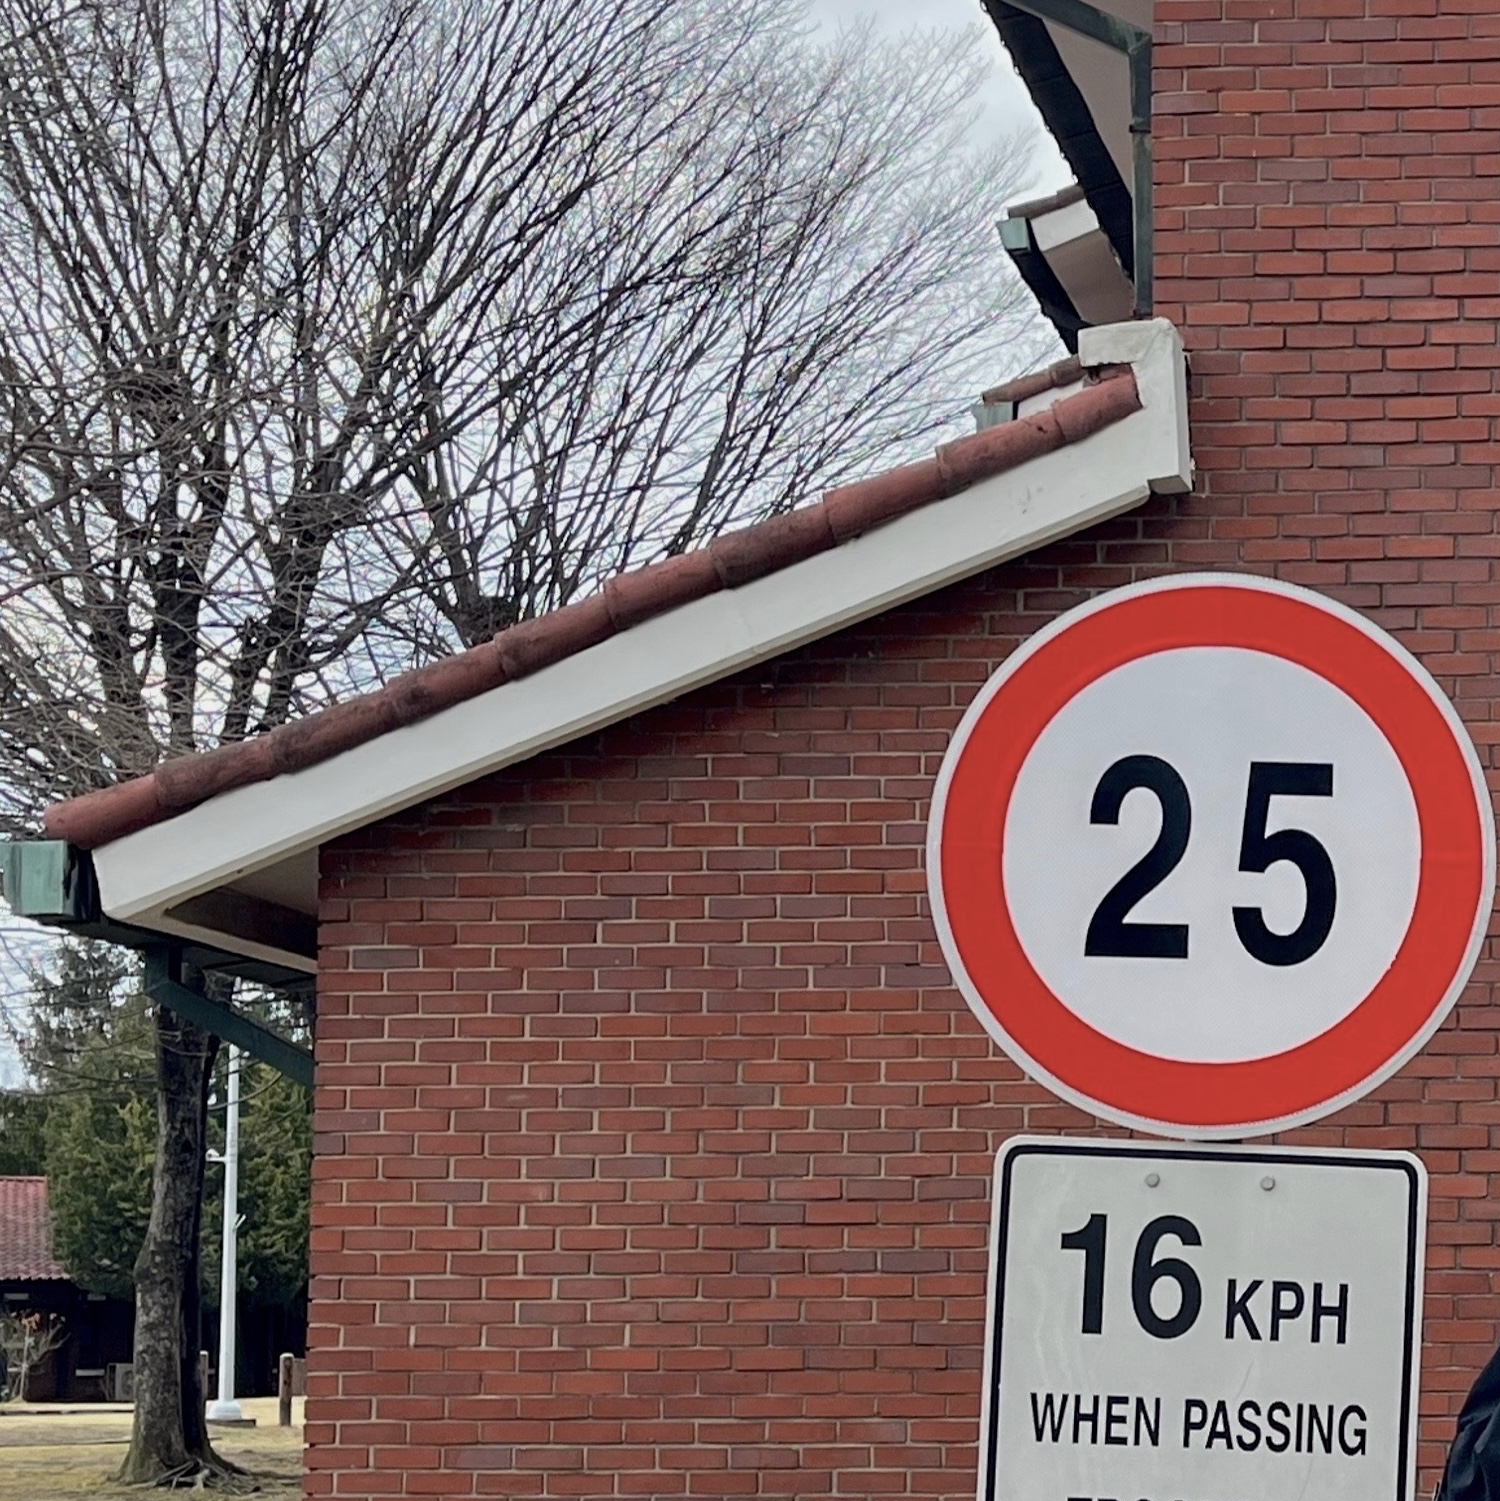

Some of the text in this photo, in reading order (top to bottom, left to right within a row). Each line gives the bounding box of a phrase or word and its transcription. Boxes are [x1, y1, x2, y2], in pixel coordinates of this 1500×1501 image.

[1084, 754, 1337, 967] 25
[1060, 1213, 1349, 1345] 16 KPH
[1030, 1392, 1367, 1457] WHEN PASSING
